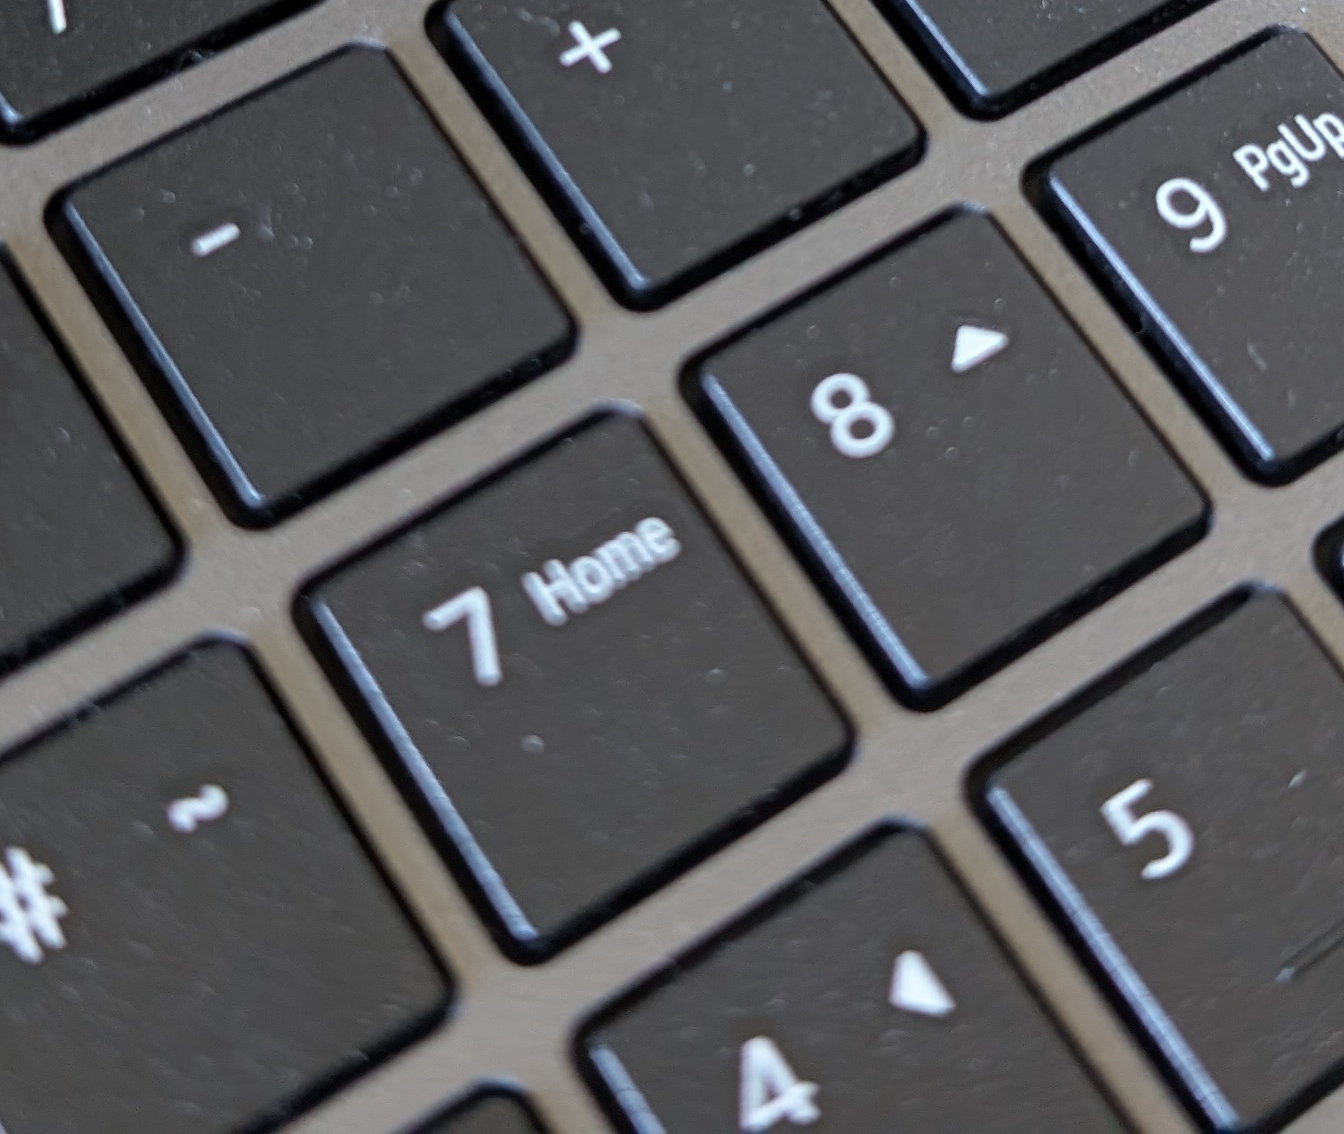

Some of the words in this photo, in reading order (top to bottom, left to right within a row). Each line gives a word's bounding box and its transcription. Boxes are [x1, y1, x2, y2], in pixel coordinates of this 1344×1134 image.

[558, 19, 623, 75] +
[1154, 176, 1229, 254] 9
[809, 371, 896, 460] 8
[422, 585, 503, 686] 7
[521, 515, 682, 626] Home
[1099, 777, 1195, 880] 5
[739, 1035, 821, 1134] 4
